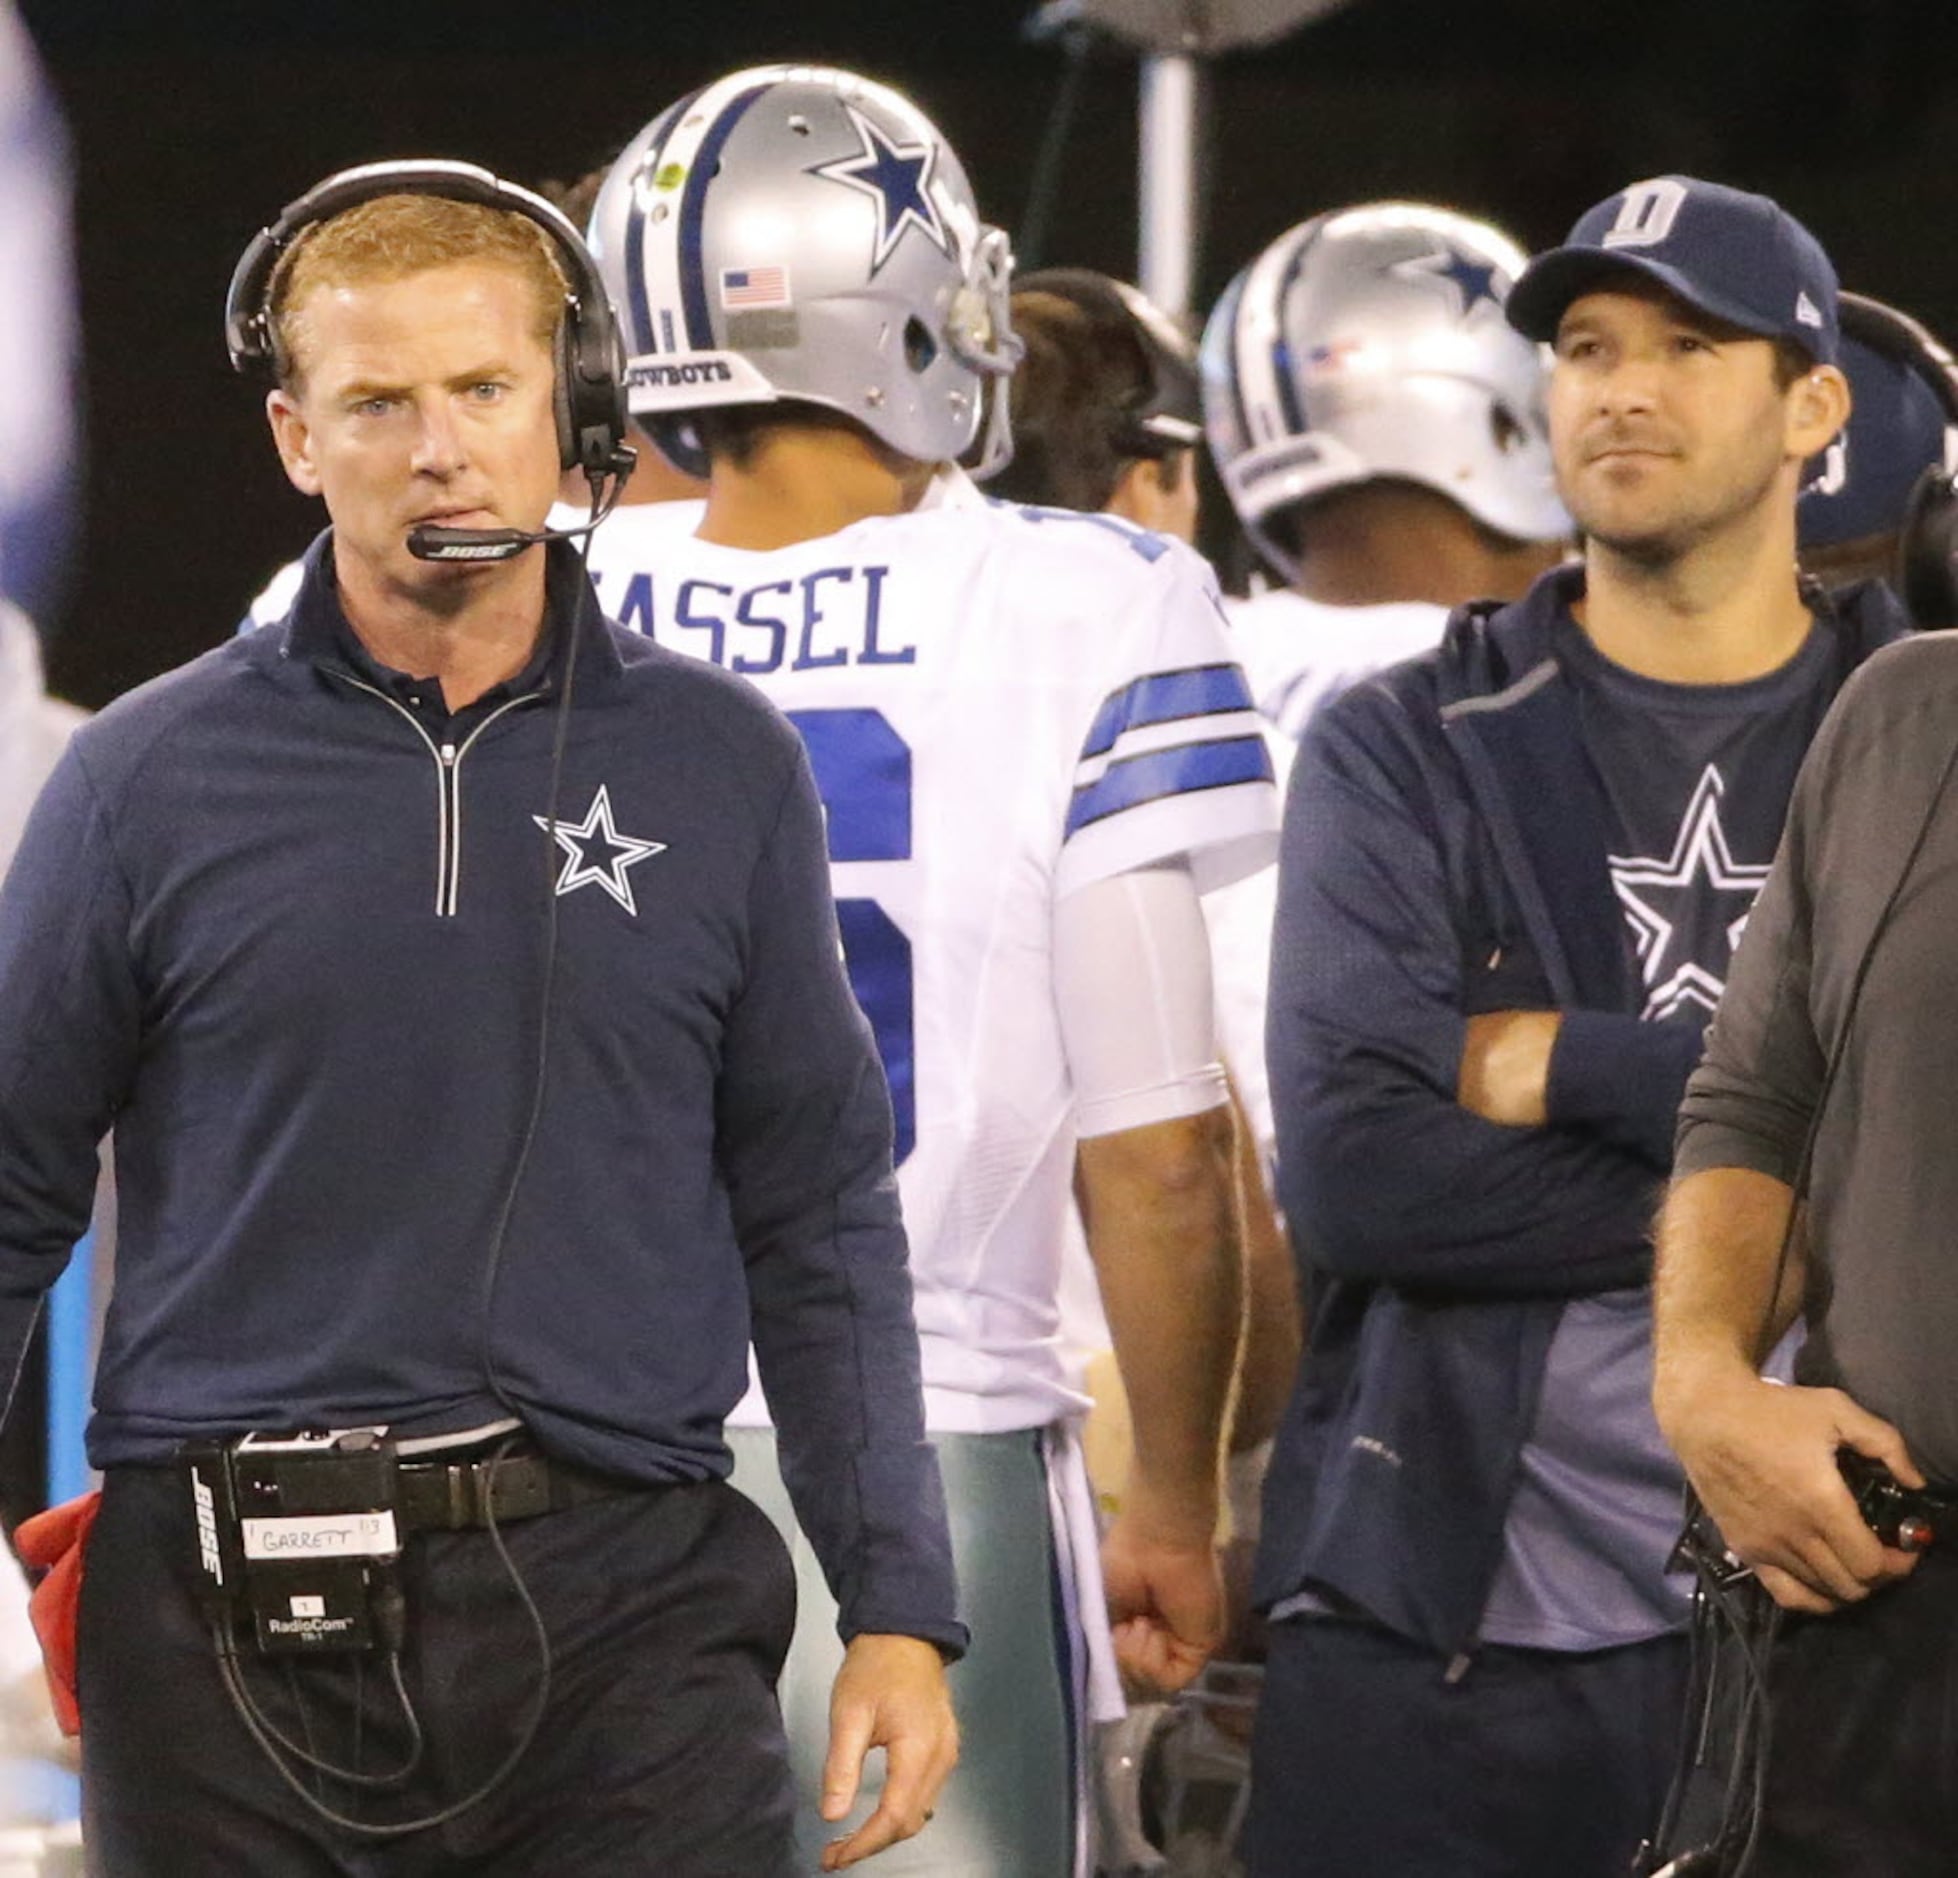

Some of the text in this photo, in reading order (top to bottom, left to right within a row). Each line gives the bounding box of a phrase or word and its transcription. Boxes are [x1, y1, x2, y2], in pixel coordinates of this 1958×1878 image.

[1602, 177, 1688, 250] D
[627, 361, 732, 387] OWBOYS
[426, 543, 517, 558] BOSE
[588, 566, 917, 674] ASSEL
[191, 1466, 223, 1586] BOSE
[263, 1530, 353, 1551] GARRETT
